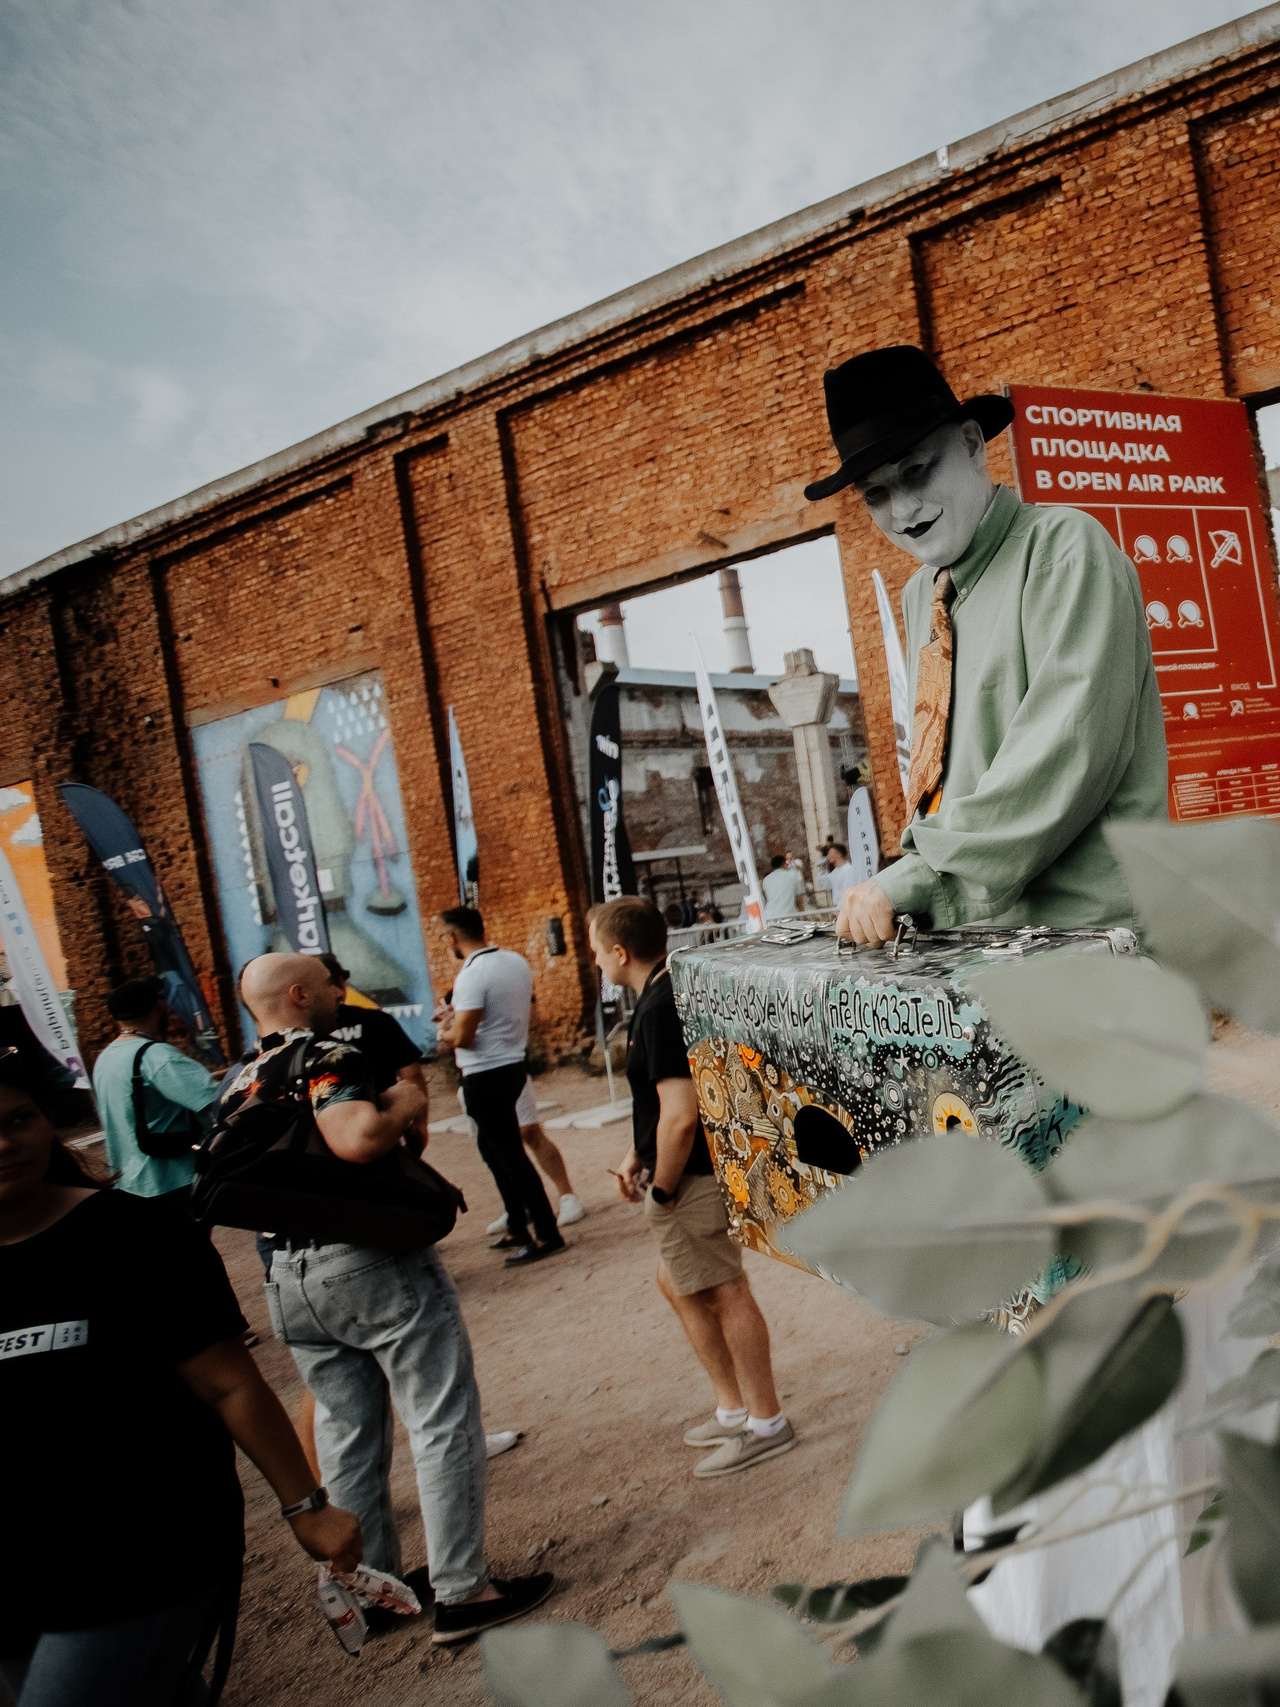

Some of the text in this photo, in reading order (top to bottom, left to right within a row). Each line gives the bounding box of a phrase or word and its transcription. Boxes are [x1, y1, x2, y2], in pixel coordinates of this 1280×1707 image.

[1025, 404, 1182, 432] СПОРТИВНАЯ
[1030, 437, 1170, 463] ПЛОЩАДКА
[1036, 470, 1226, 495] В OPEN AIR PARK
[1153, 664, 1178, 672] ИВНОЙ
[1230, 682, 1251, 691] ВХОД
